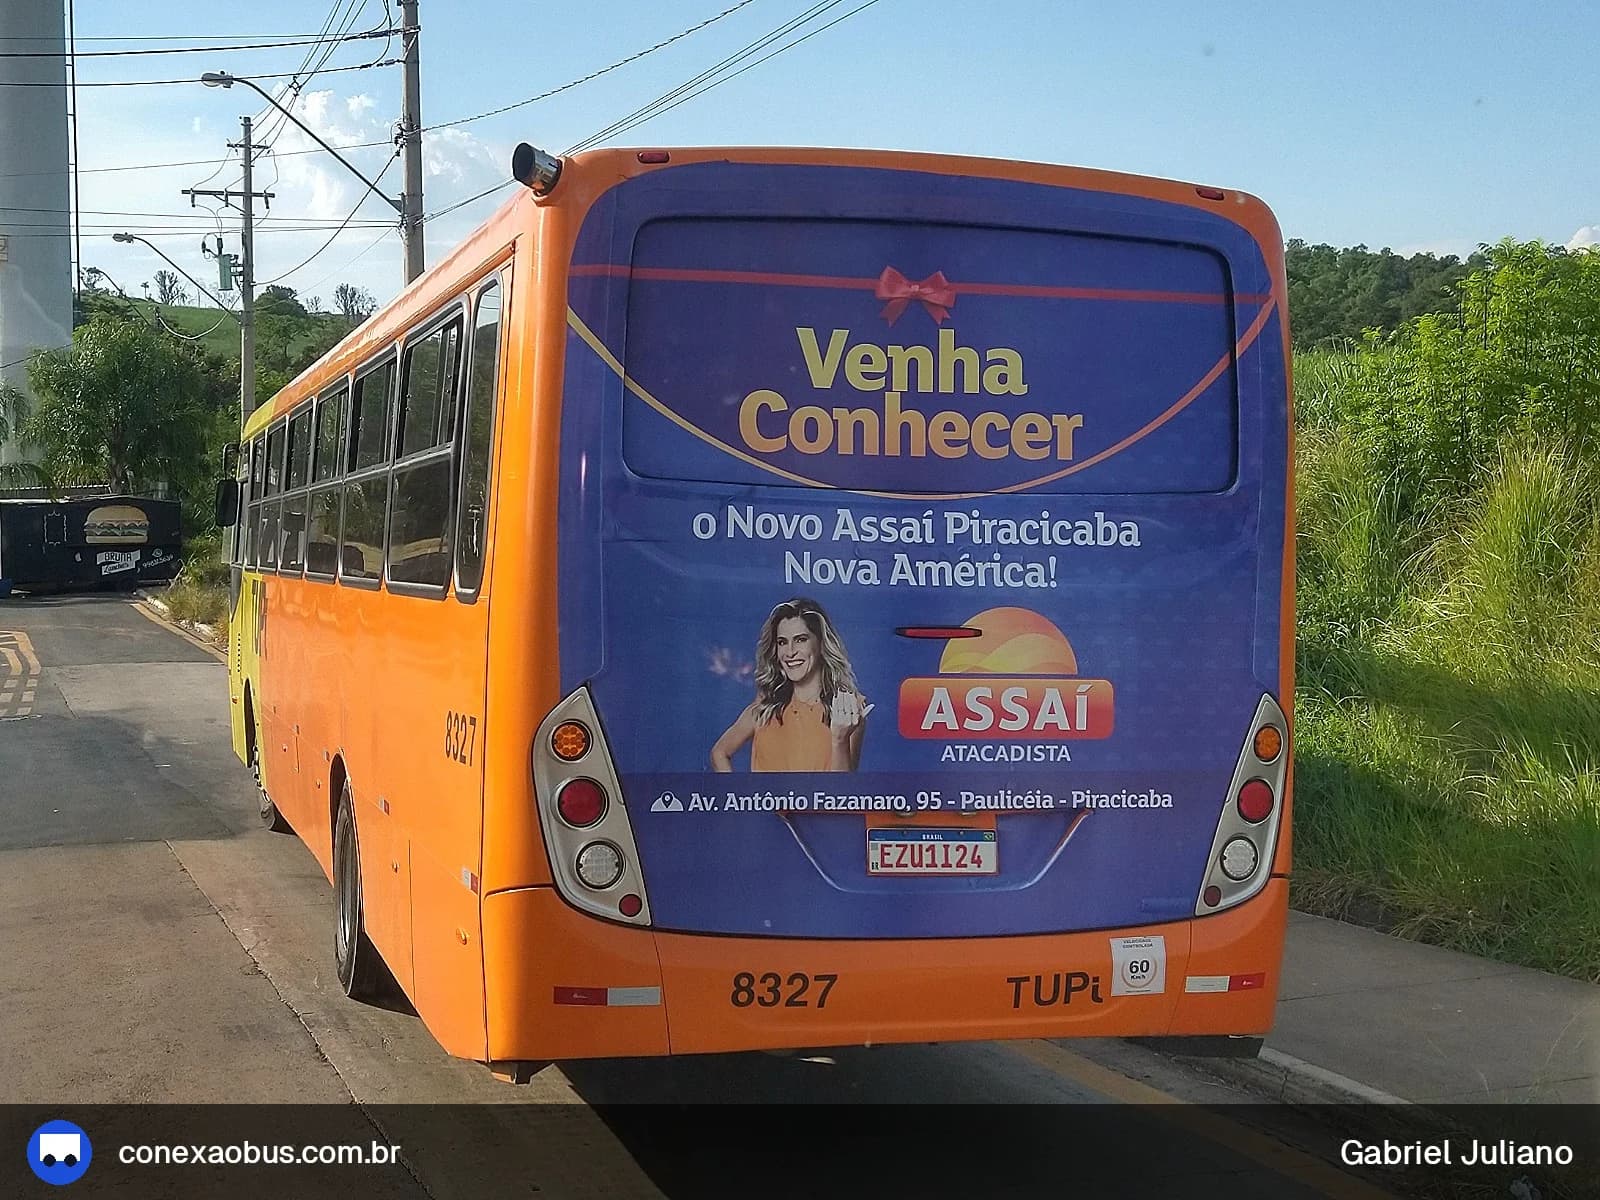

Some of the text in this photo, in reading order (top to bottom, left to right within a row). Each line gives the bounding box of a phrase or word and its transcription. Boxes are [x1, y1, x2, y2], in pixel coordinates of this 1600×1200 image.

[796, 327, 1028, 396] Venha
[738, 389, 1084, 461] Conhecer
[692, 505, 1142, 547] o Novo Assaí Piracicaba
[784, 551, 1058, 588] Nova América!
[446, 710, 476, 767] 8327
[941, 745, 1072, 762] ATACADISTA
[688, 792, 719, 811] Av.
[724, 791, 808, 811] Antônio
[812, 791, 912, 812] Fazanaro,
[916, 791, 942, 810] 95
[960, 789, 1054, 810] Paulicéia
[1071, 789, 1173, 809] Piracicaba
[880, 843, 982, 869] EZU1I24
[1129, 960, 1150, 974] 60
[730, 971, 838, 1009] 8327
